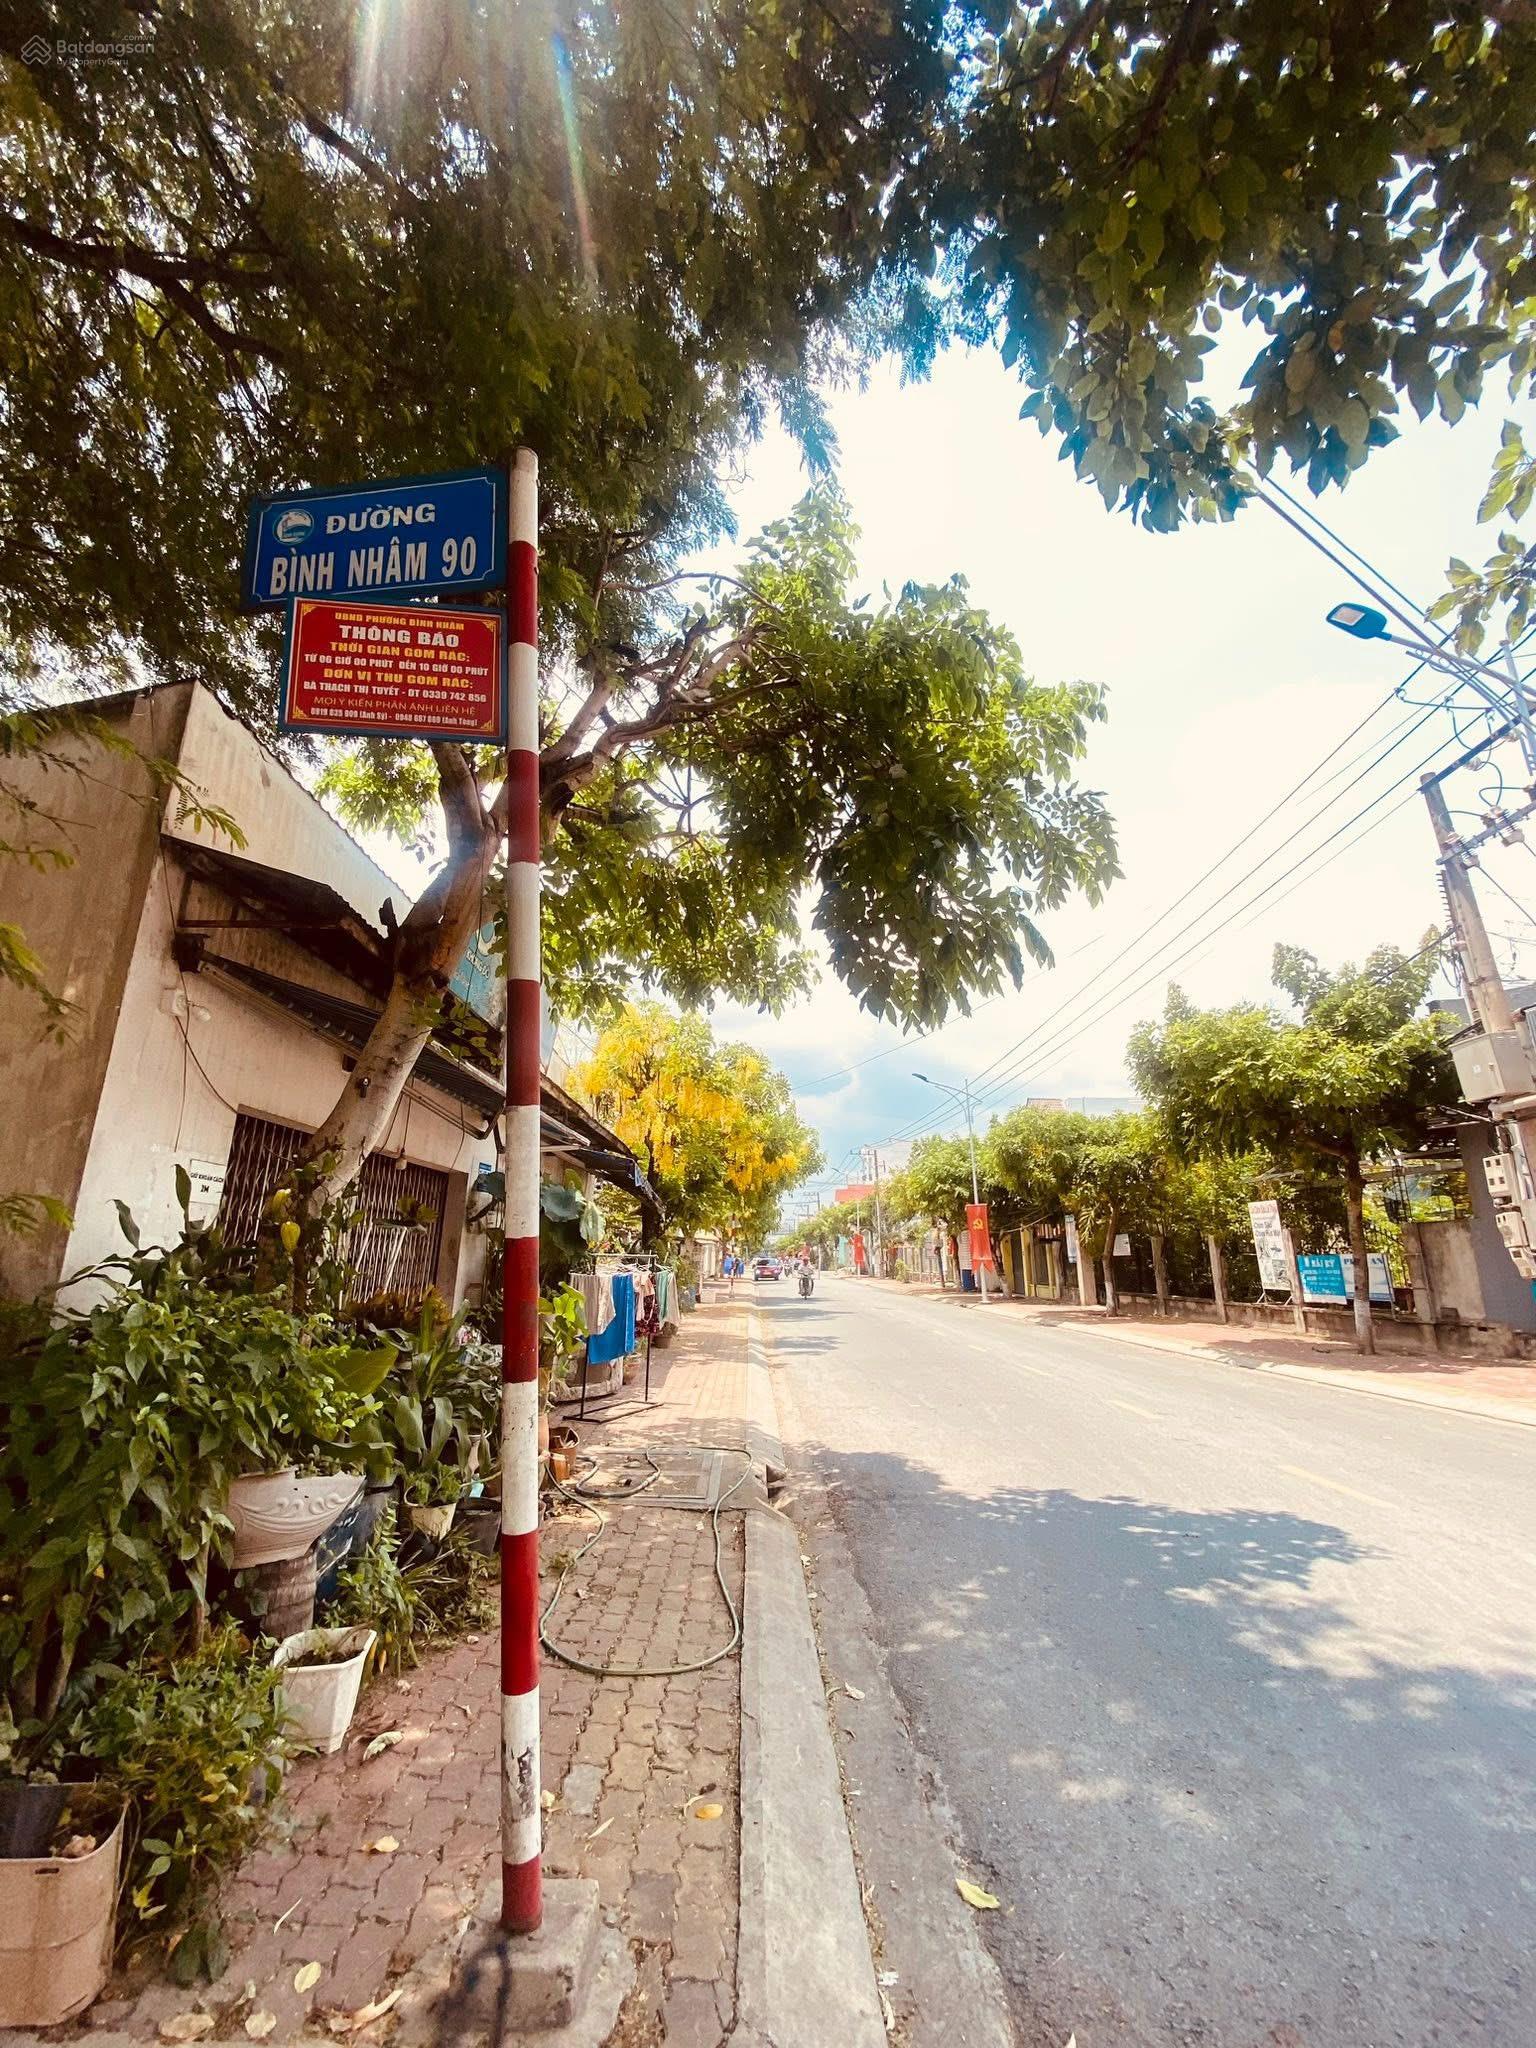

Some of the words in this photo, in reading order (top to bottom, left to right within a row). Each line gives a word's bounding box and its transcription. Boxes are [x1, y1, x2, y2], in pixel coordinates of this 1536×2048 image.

[326, 502, 436, 535] ĐƯỜNG
[270, 547, 334, 596] BÌNH
[347, 536, 427, 588] NHÂM
[441, 536, 477, 577] 90
[335, 612, 363, 622] UBND
[366, 614, 406, 626] PHƯỜNG
[409, 618, 433, 628] BÌNH
[339, 624, 410, 644] THÔNG
[418, 631, 459, 647] BÁO
[330, 641, 363, 653] THỜI
[367, 645, 400, 656] GIAN
[404, 647, 435, 659] GOM
[439, 649, 470, 662] RÁC:
[304, 653, 318, 662] TỪ
[335, 656, 352, 666] GIỜ
[369, 658, 394, 669] PHÚT
[399, 660, 417, 671] ĐẾN
[419, 662, 430, 671] 10
[432, 663, 449, 673] GIỜ
[465, 666, 489, 677] PHÚT
[323, 668, 353, 680] ĐƠN
[357, 670, 372, 683] VỊ
[376, 672, 403, 683] THU
[407, 674, 438, 686] GOM
[442, 676, 473, 689] RÁC:
[303, 680, 317, 690] BÀ
[353, 684, 369, 695] THỊ
[372, 684, 400, 696] TUYẾT
[449, 692, 466, 701] 742
[313, 696, 336, 706] MỌI
[348, 697, 373, 708] KIẾN
[409, 701, 433, 712] ÁNH
[436, 703, 459, 714] LIÊN
[461, 706, 476, 717] HỆ
